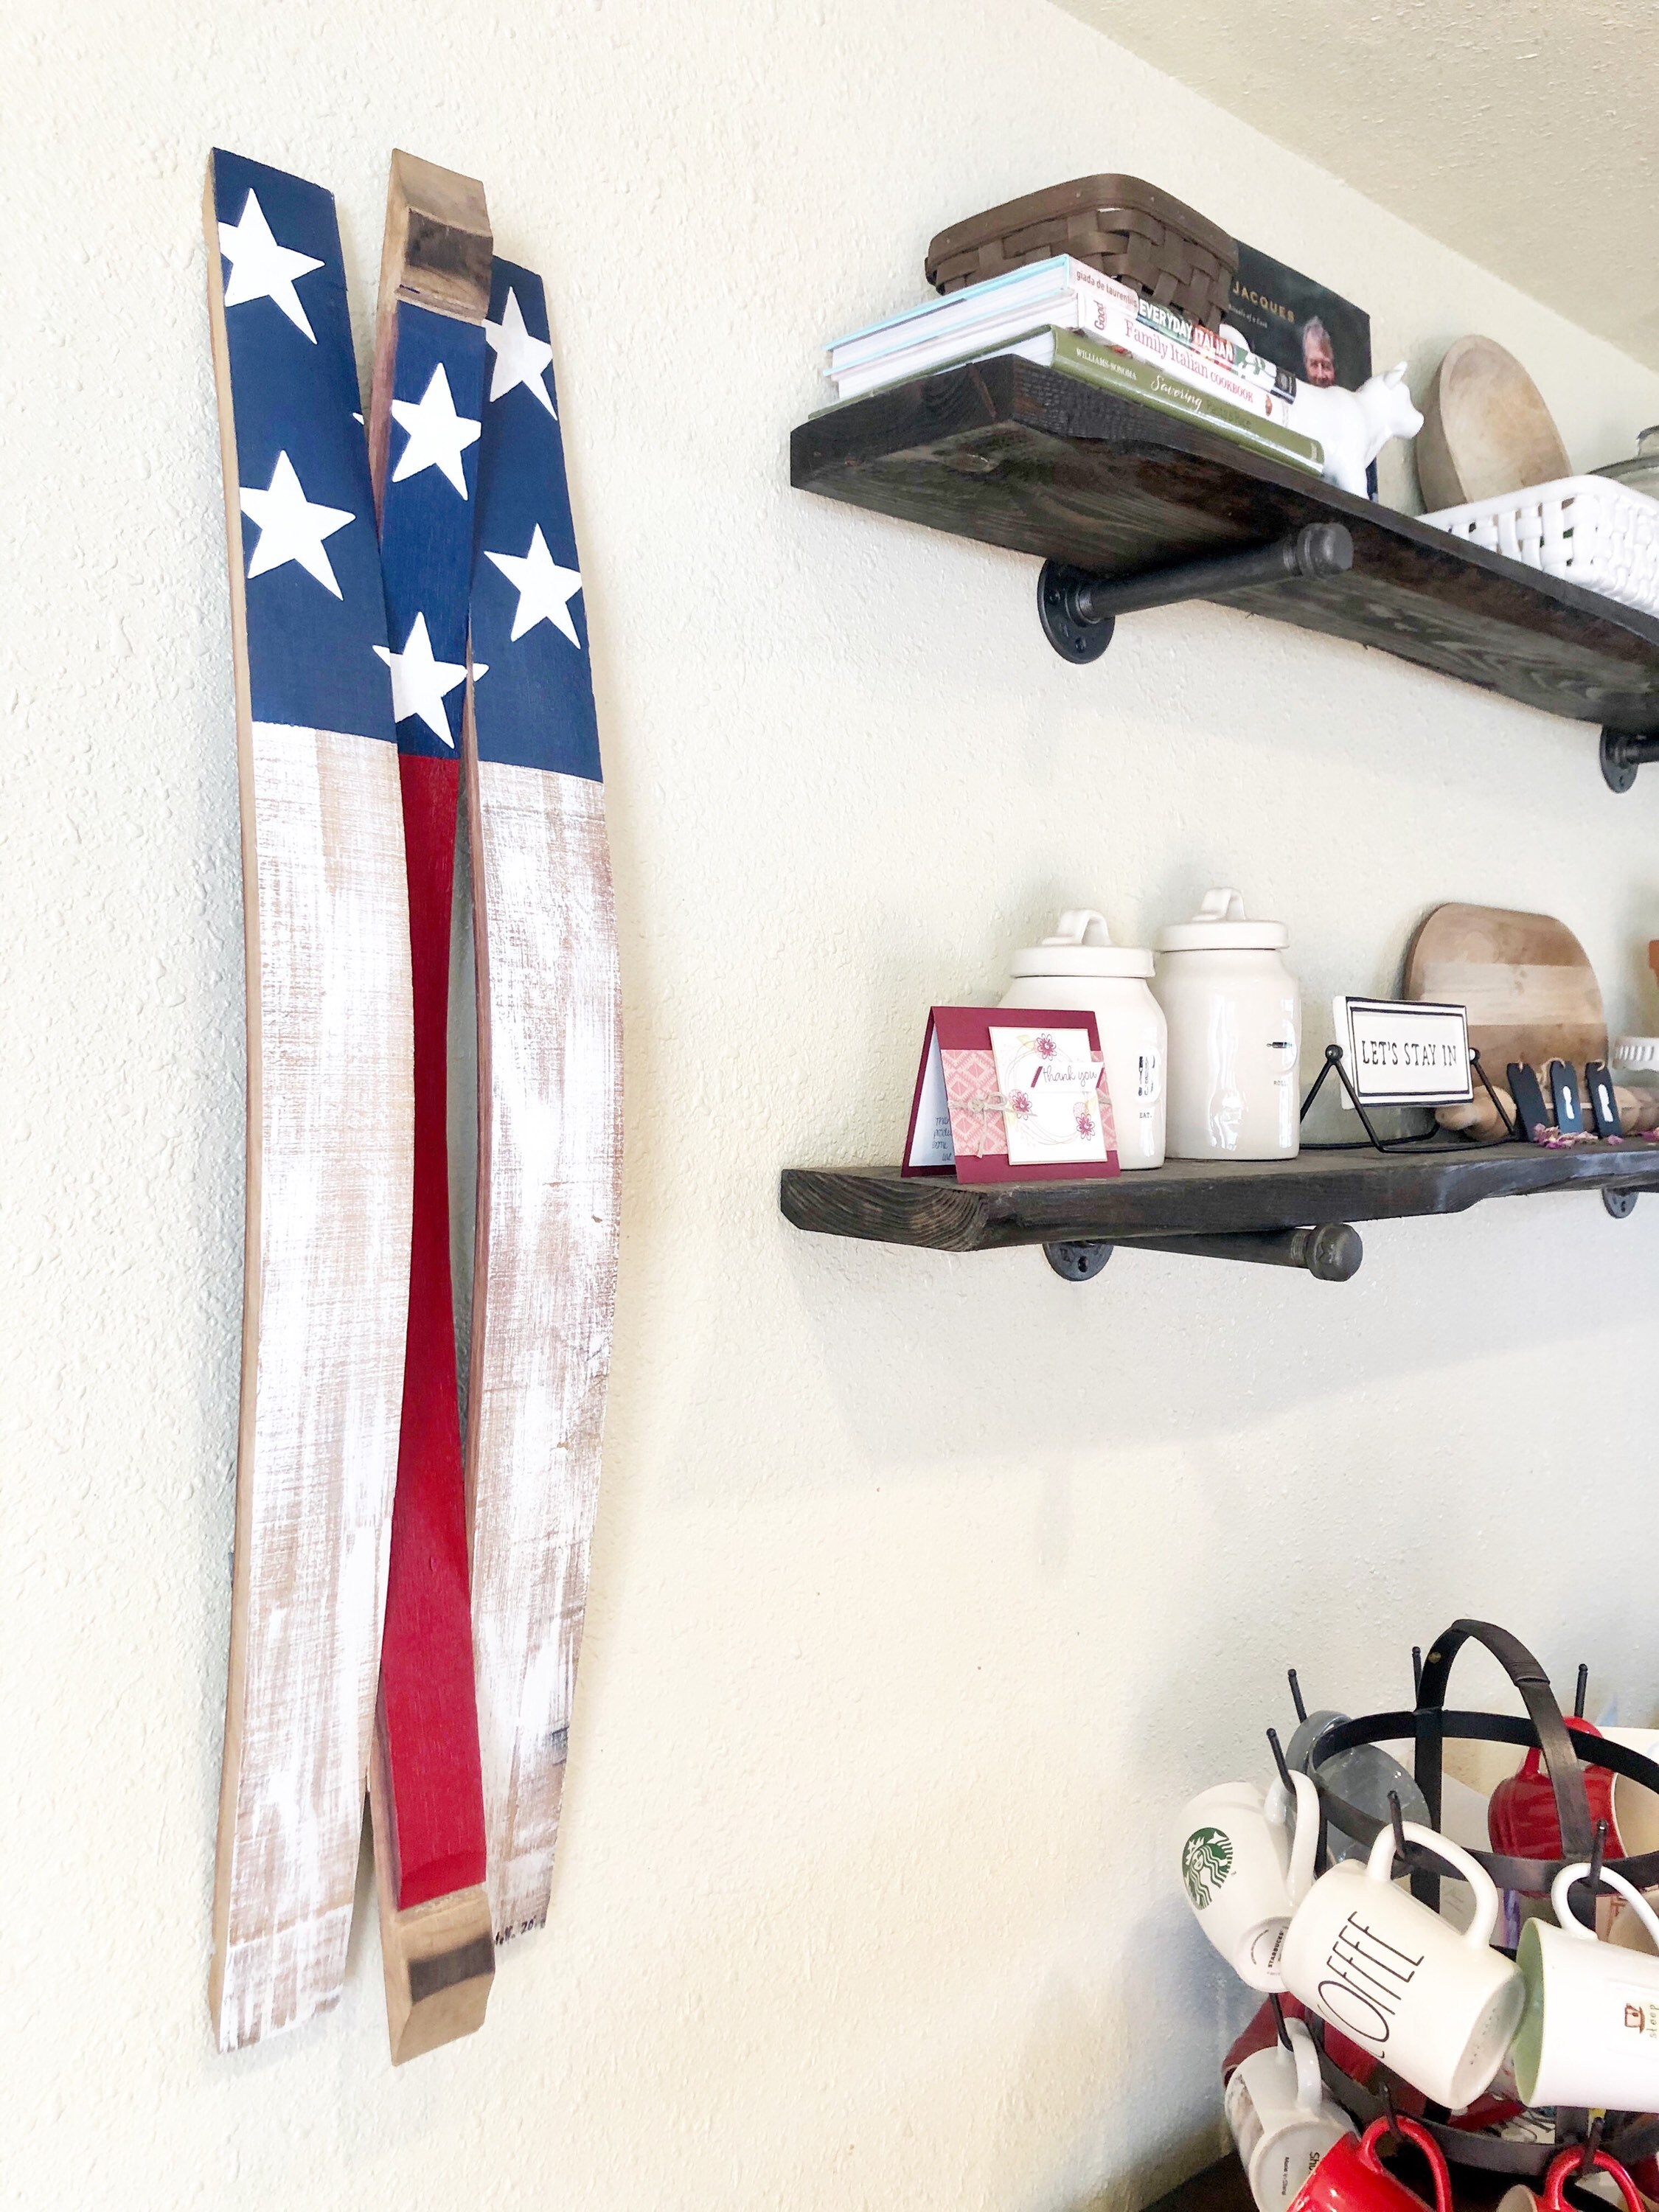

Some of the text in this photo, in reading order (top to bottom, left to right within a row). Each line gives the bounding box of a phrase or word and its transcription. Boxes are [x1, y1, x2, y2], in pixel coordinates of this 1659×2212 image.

[1077, 271, 1095, 286] giada
[1096, 279, 1105, 291] de
[1093, 300, 1106, 330] Good
[1232, 281, 1295, 323] JACQUES
[1139, 298, 1193, 342] EVERYDAY
[1194, 326, 1234, 364] ITALIAN
[1124, 319, 1168, 359] Family
[1170, 343, 1208, 378] Italian
[1210, 372, 1253, 403] COOKBOOK
[1150, 375, 1203, 413] Savoring
[1362, 1040, 1457, 1066] LET'S STAY IN
[1043, 1065, 1097, 1087] thank you
[1267, 1931, 1284, 1967] STARBUCKS
